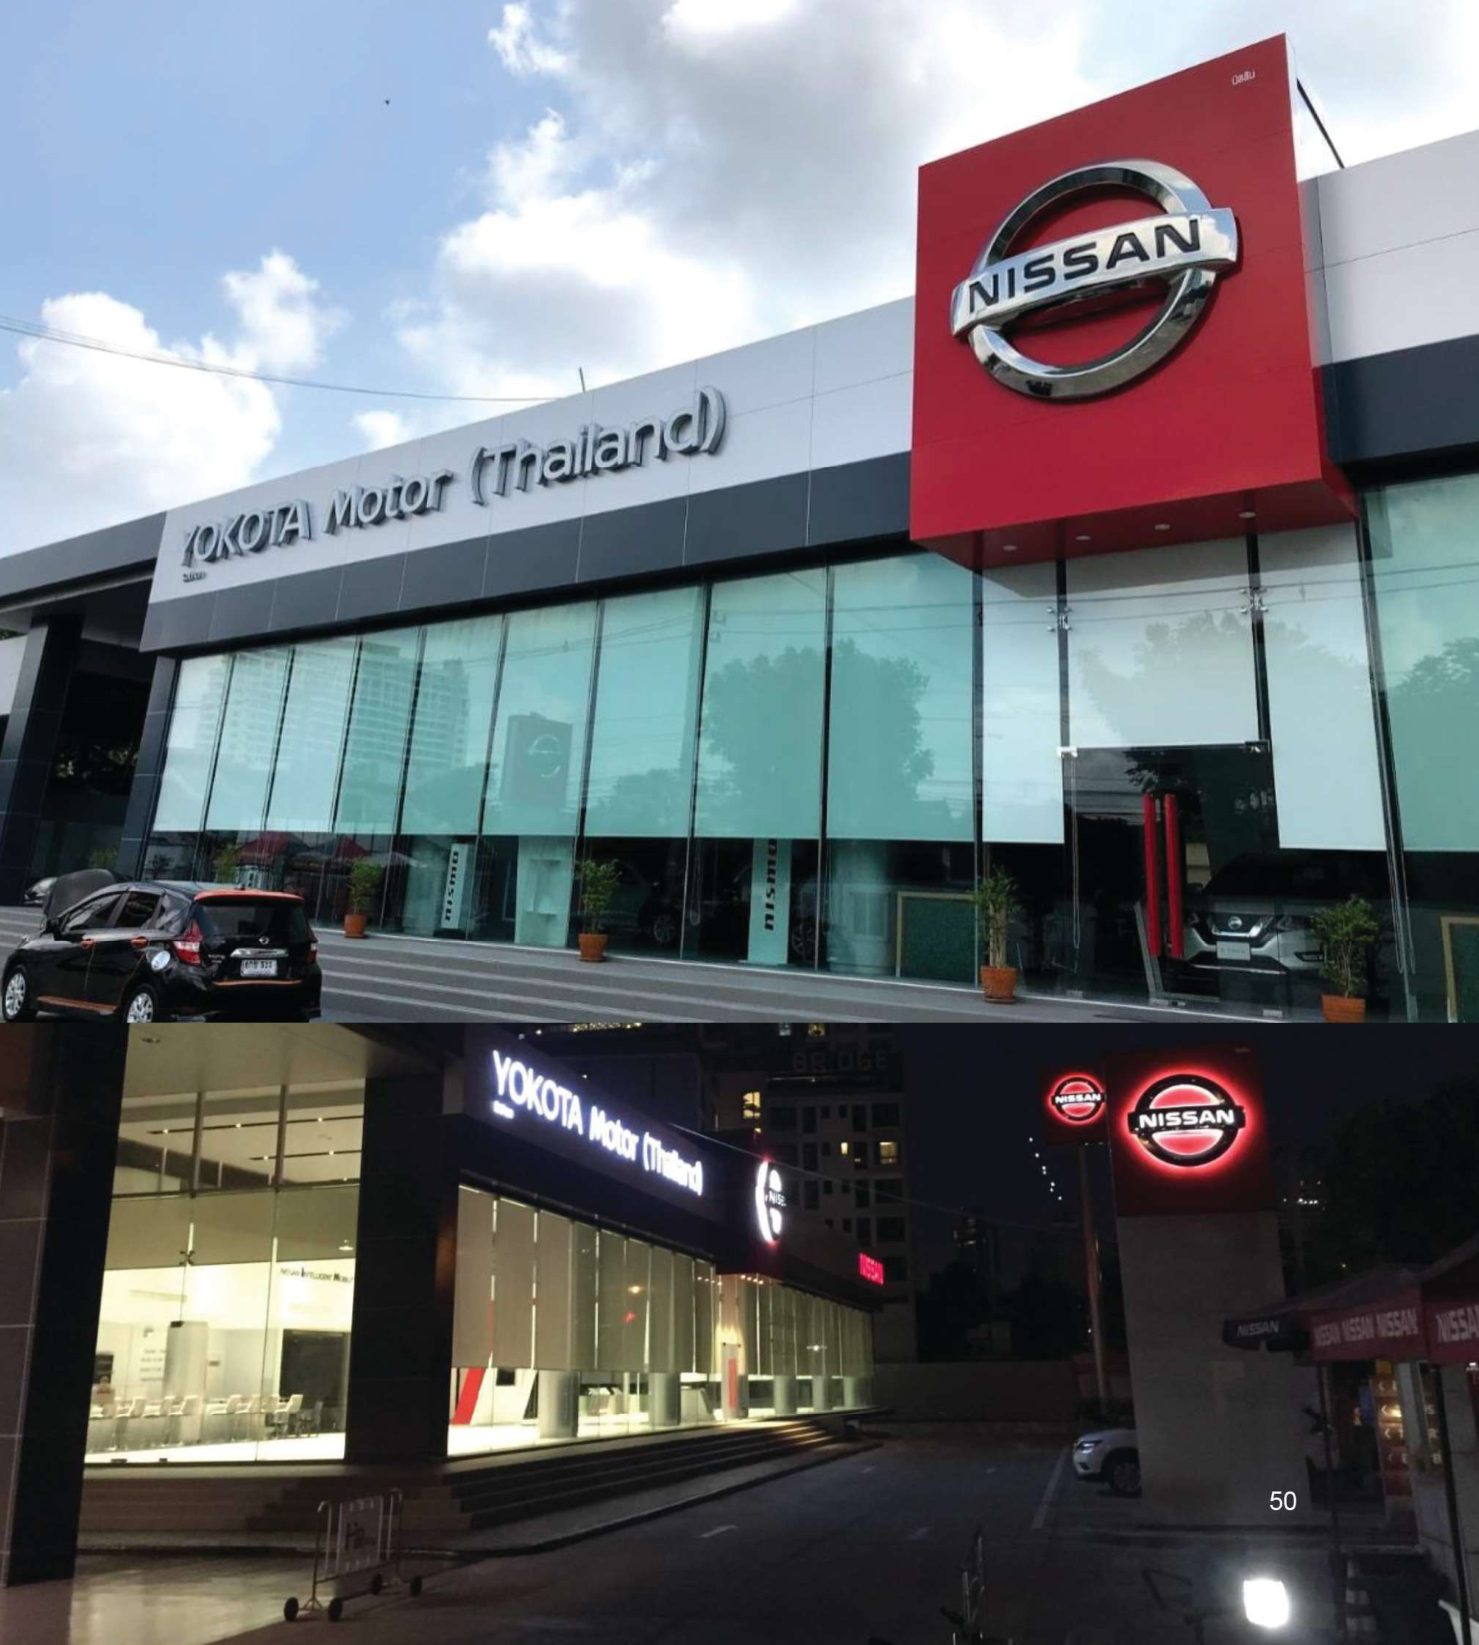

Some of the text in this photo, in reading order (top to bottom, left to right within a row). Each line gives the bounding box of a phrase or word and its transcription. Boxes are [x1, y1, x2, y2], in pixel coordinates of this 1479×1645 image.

[968, 218, 1201, 314] NISSAN
[182, 385, 726, 567] YOKOTA Motor (Thailand)
[791, 1049, 888, 1072] BRDGE
[1054, 1092, 1102, 1104] NISSAN
[491, 1049, 704, 1197] YOKOTA Motor (Thailand)
[1138, 1109, 1236, 1130] NISSAN
[1237, 1319, 1280, 1337] NISSAN
[1375, 1307, 1419, 1338] NISSAN
